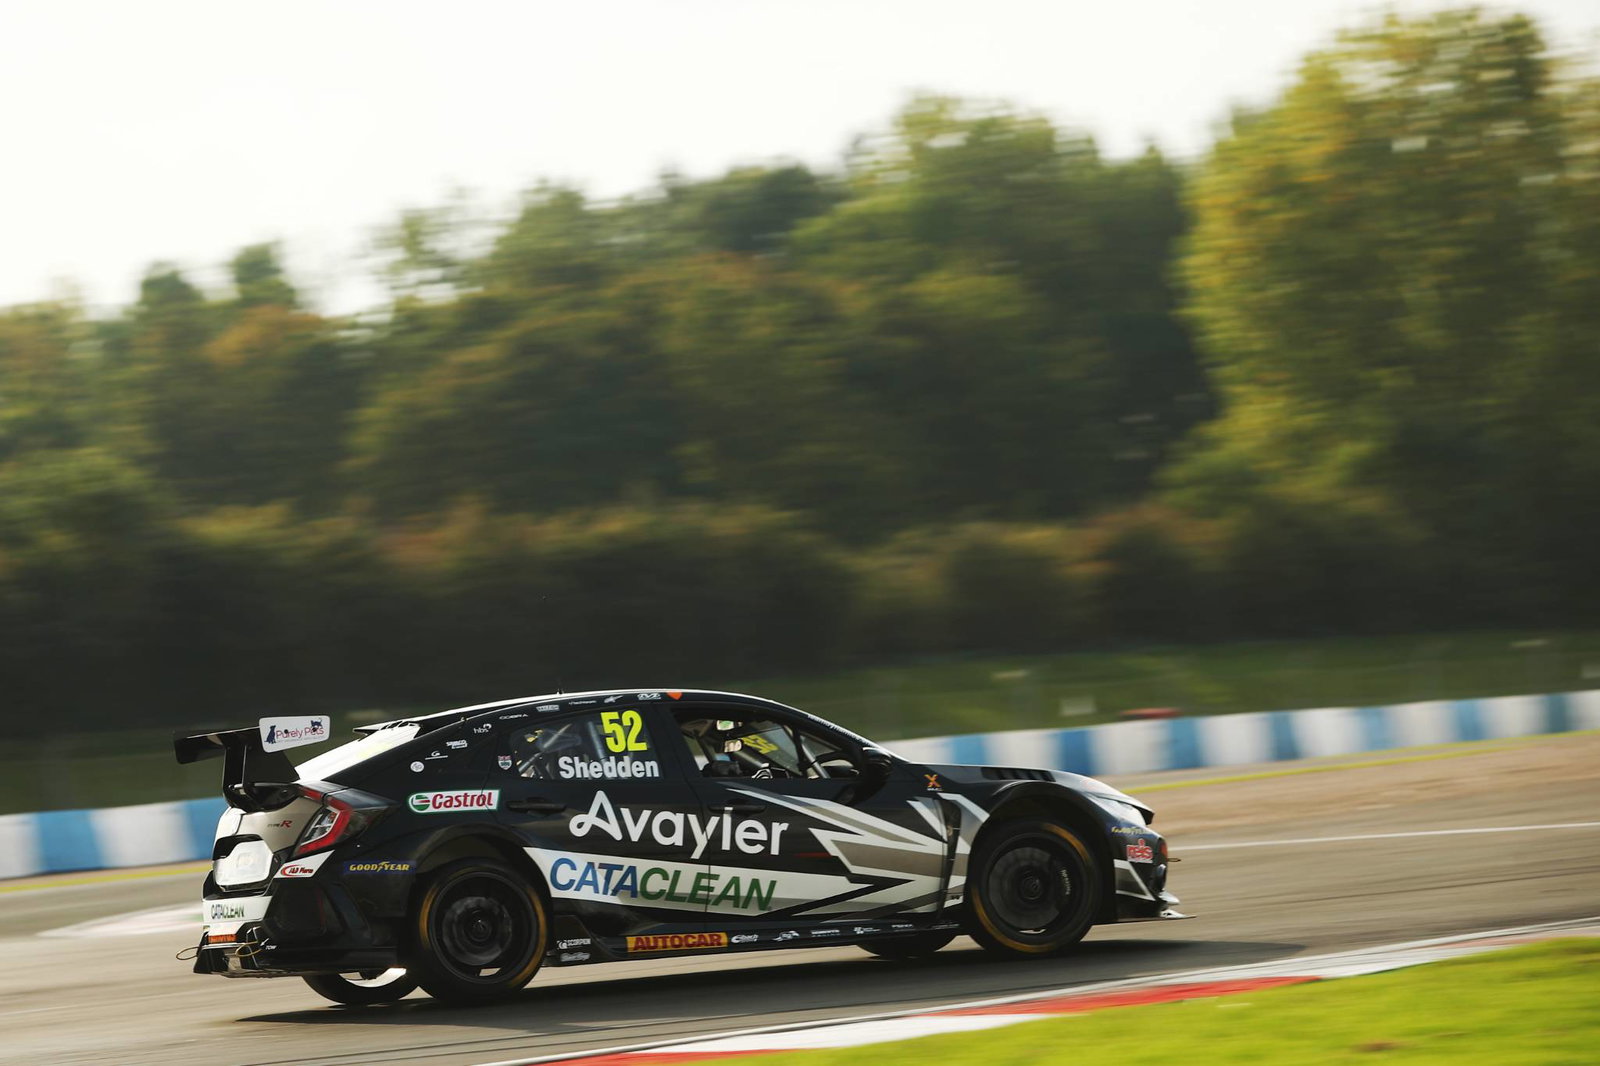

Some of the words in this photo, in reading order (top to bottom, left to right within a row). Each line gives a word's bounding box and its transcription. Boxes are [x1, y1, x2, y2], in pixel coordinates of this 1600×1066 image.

[276, 728, 304, 739] Purely
[304, 727, 325, 736] Pets
[600, 710, 648, 753] 52
[558, 756, 660, 779] Shedden
[431, 792, 493, 810] Castrol
[568, 790, 789, 860] Avayler
[349, 861, 410, 873] GOODYEAR
[550, 858, 778, 912] CATACLEAN
[210, 903, 245, 920] CATACLEAN
[633, 934, 722, 950] AUTOCAR
